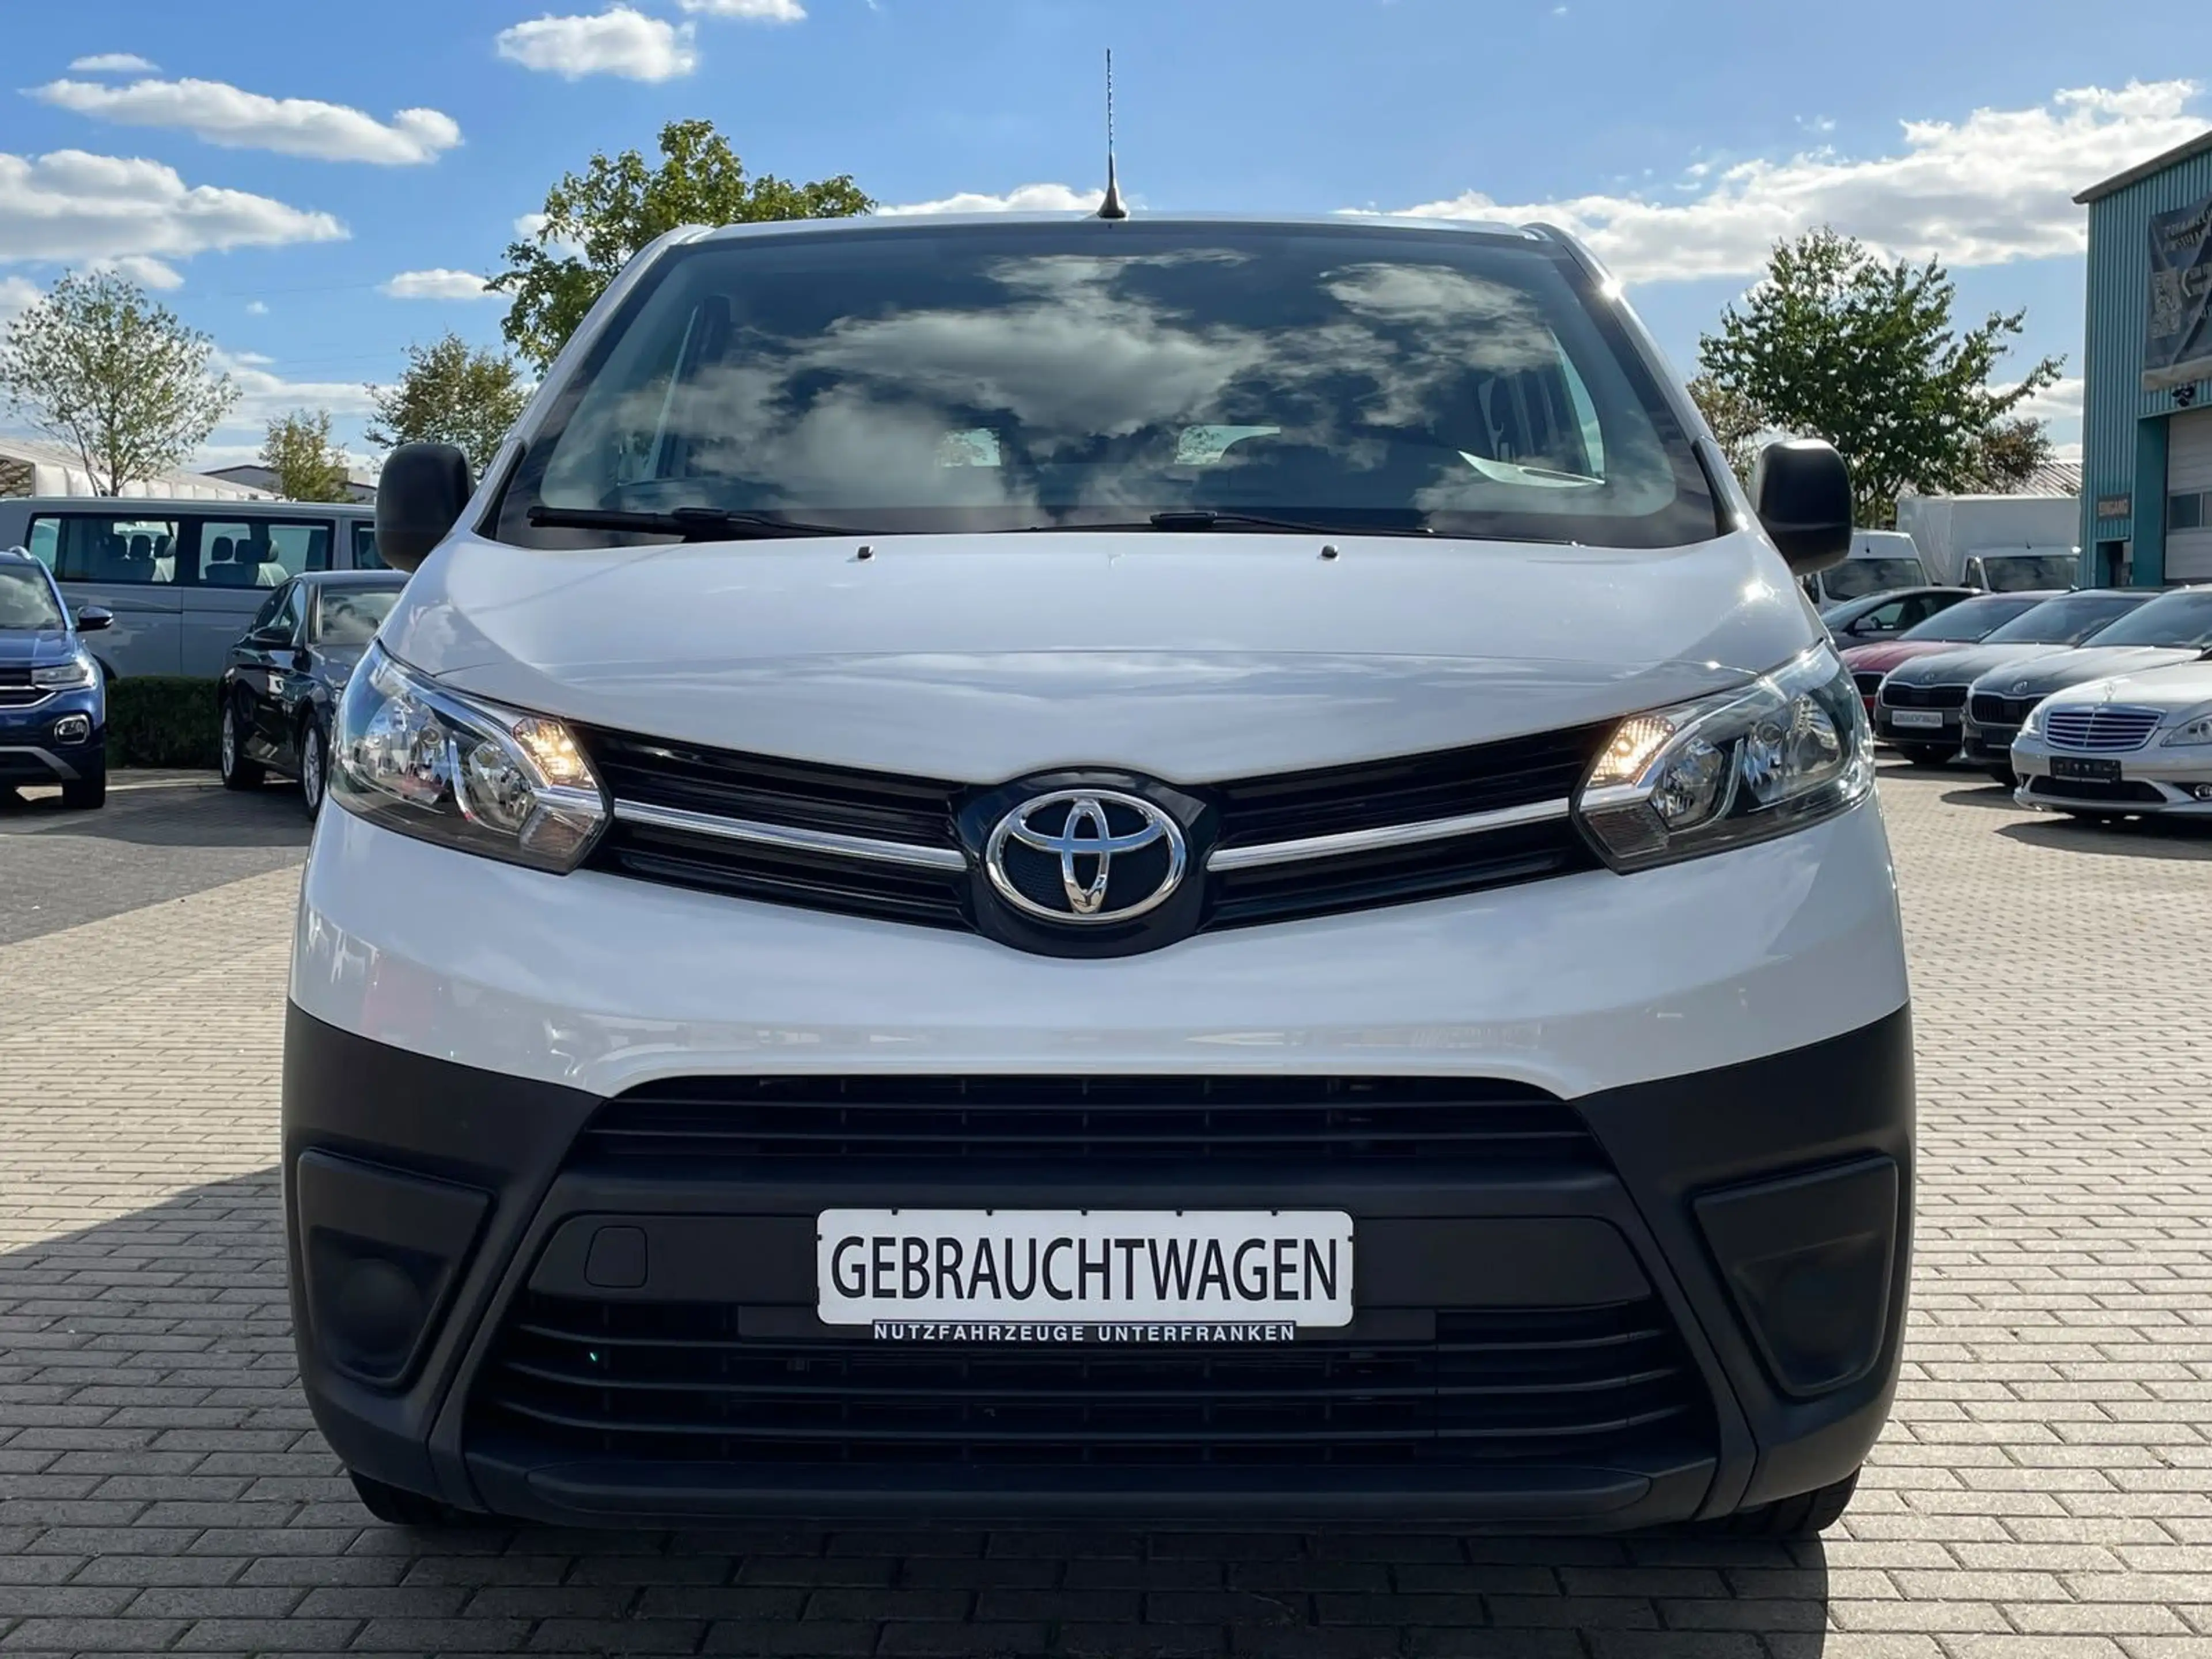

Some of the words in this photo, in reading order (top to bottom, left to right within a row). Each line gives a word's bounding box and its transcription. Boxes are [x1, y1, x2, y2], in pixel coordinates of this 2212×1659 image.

[831, 1236, 1338, 1301] GEBRAUCHTWAGEN
[874, 1324, 1085, 1341] NUTZFAHRZEUGE
[1098, 1324, 1296, 1341] UNTERFRANKEN
